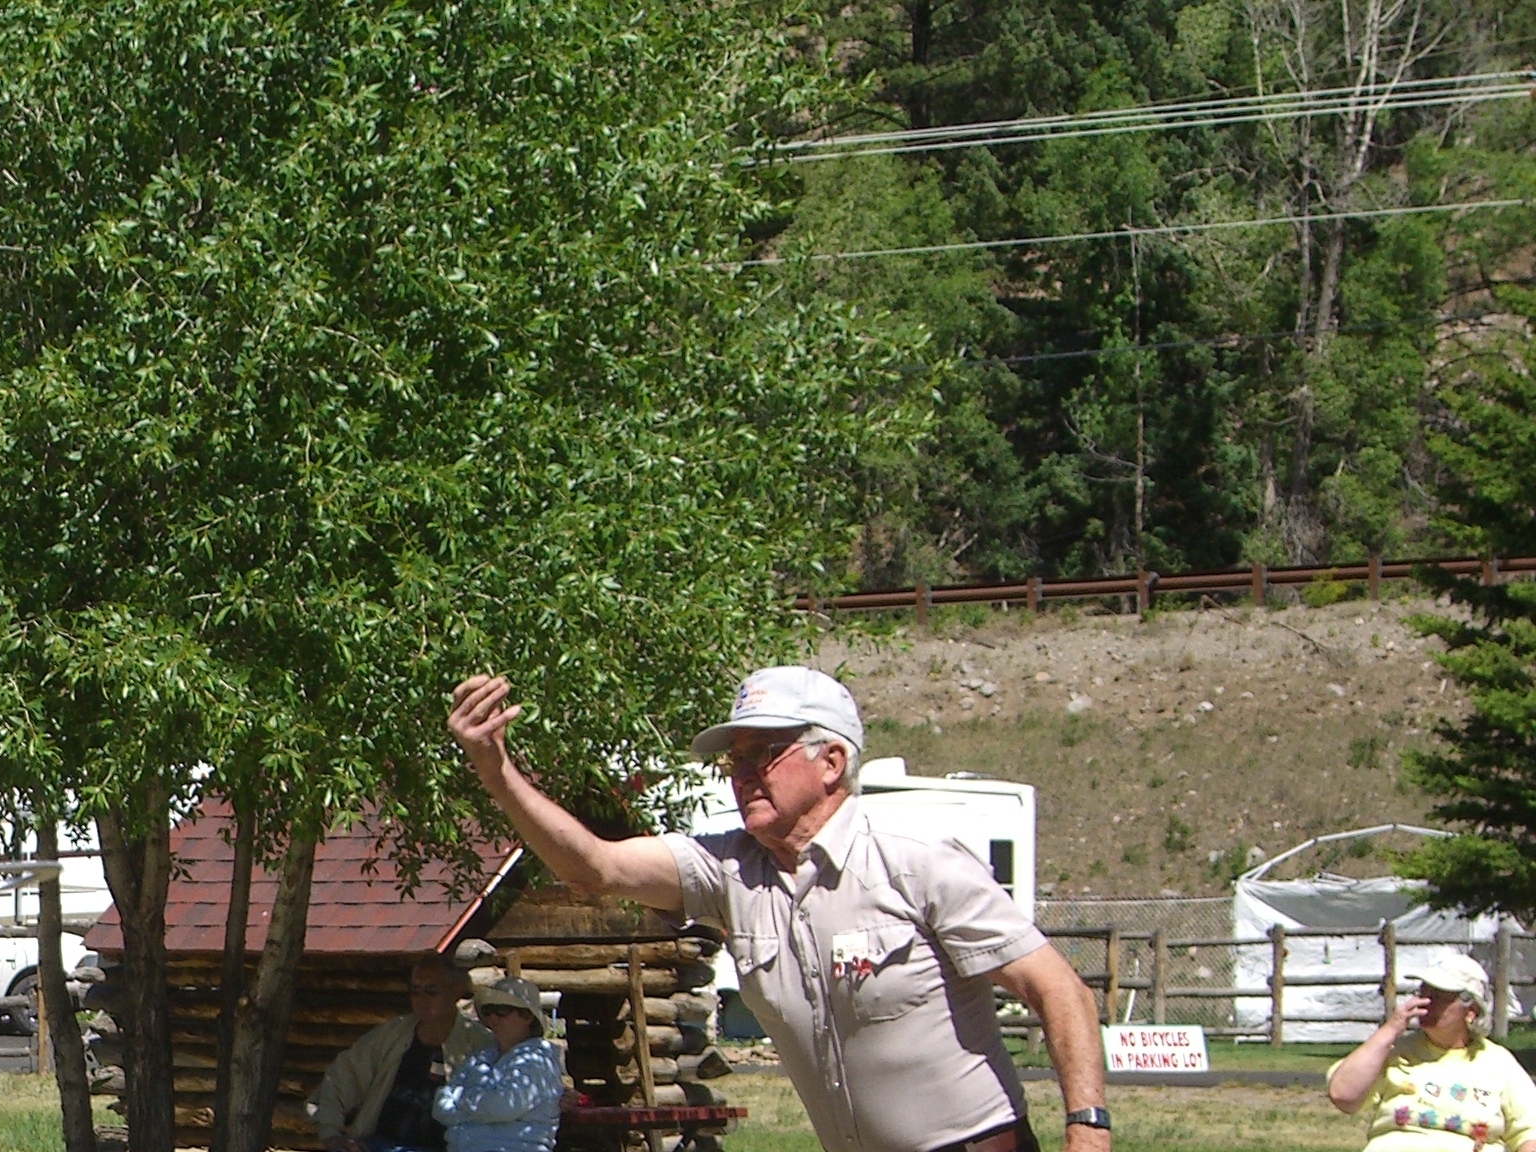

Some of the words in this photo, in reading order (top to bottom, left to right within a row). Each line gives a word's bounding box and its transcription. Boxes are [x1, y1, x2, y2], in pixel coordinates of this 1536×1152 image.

[1119, 1031, 1136, 1047] NO
[1140, 1031, 1190, 1047] BICYCLES
[1111, 1053, 1124, 1069] IN
[1127, 1053, 1179, 1070] PARKING
[1183, 1053, 1203, 1068] LOT
